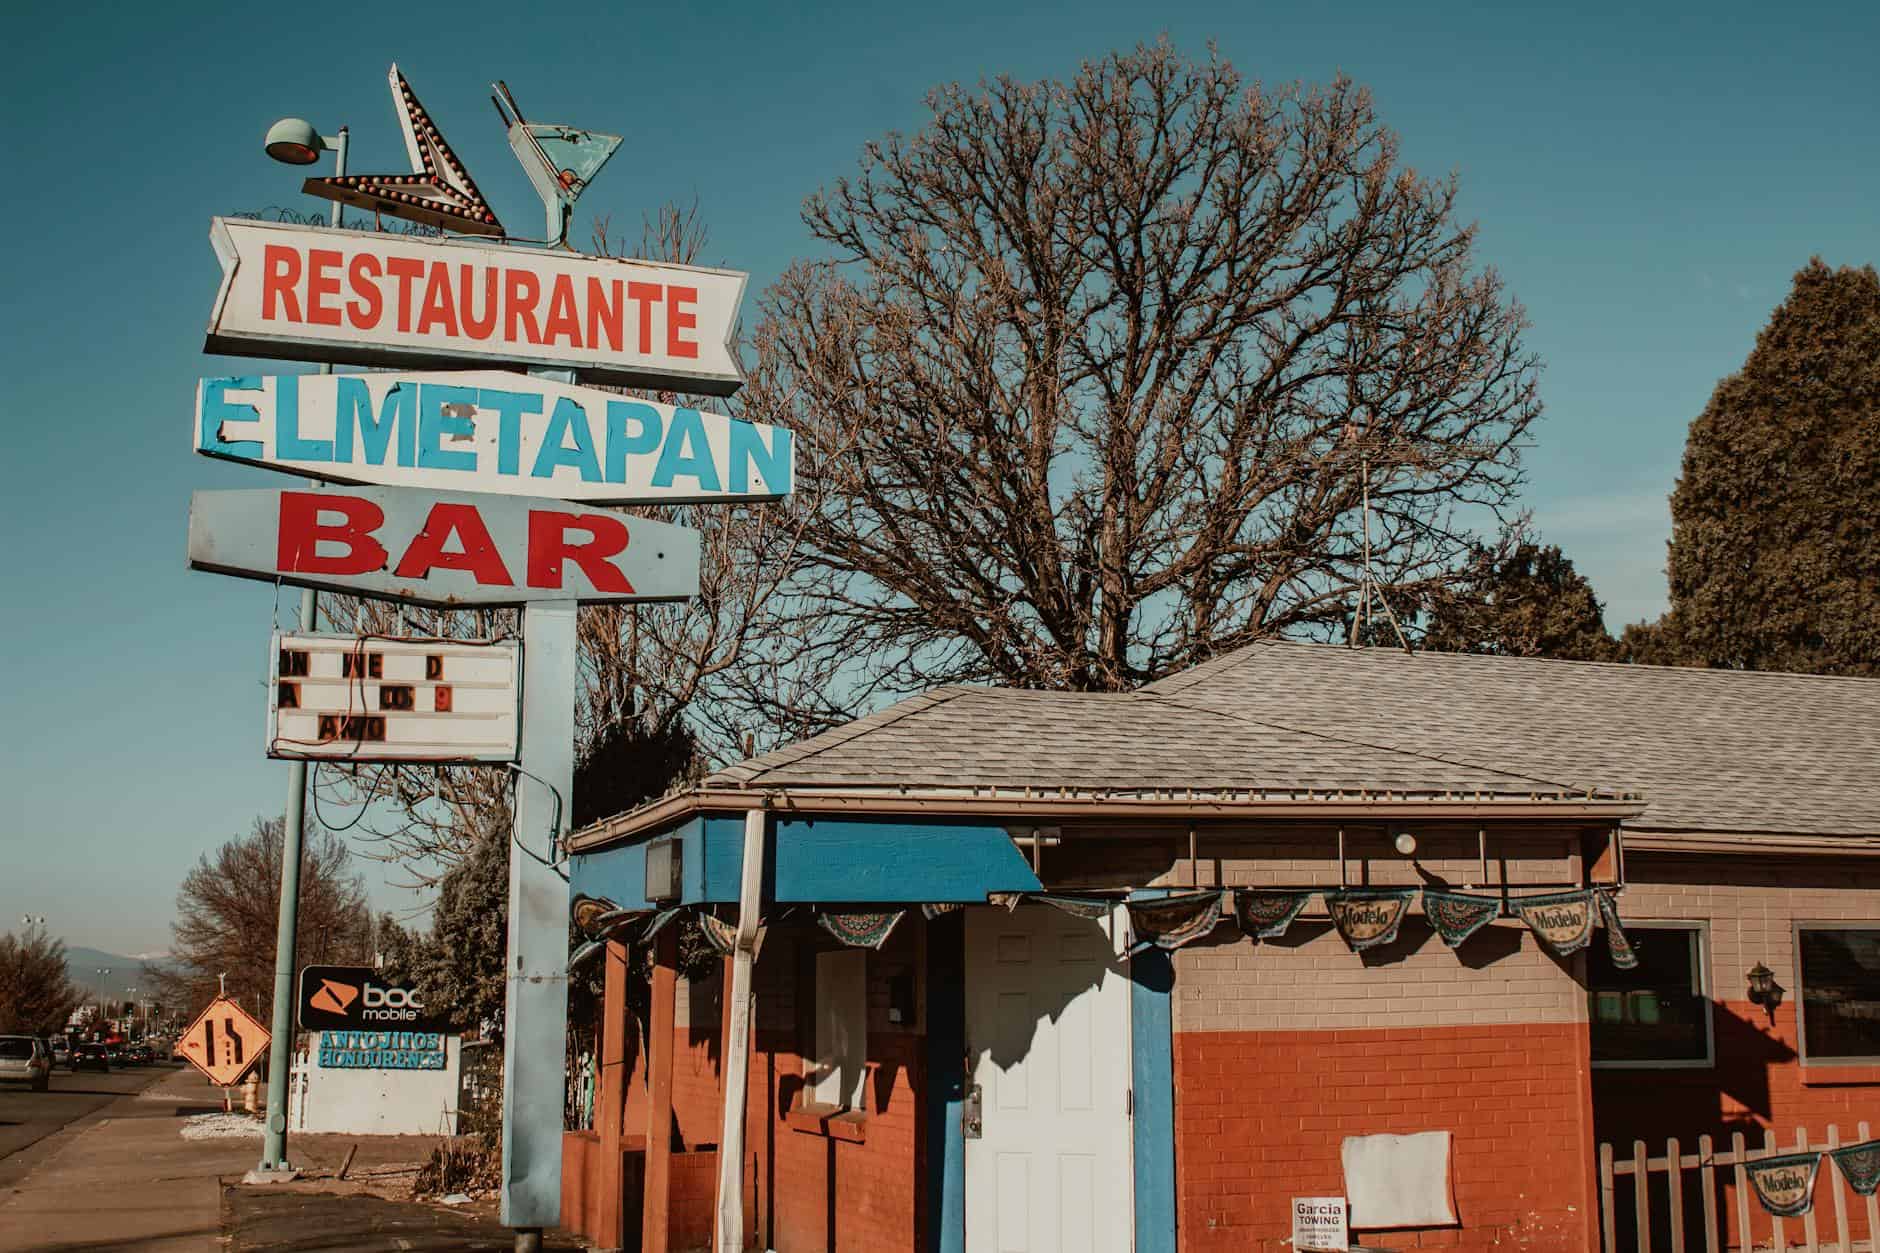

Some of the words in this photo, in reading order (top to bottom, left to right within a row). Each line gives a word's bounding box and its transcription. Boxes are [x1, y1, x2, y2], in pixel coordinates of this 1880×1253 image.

[262, 244, 699, 359] RESTAURANTE
[276, 490, 637, 594] BAR
[1535, 909, 1582, 928] Modelo
[362, 1008, 417, 1021] mobile
[319, 1030, 441, 1049] ANTOJITOS
[1762, 1171, 1805, 1193] Modelo
[1297, 1203, 1341, 1215] Garcia
[1298, 1215, 1340, 1225] TOWING
